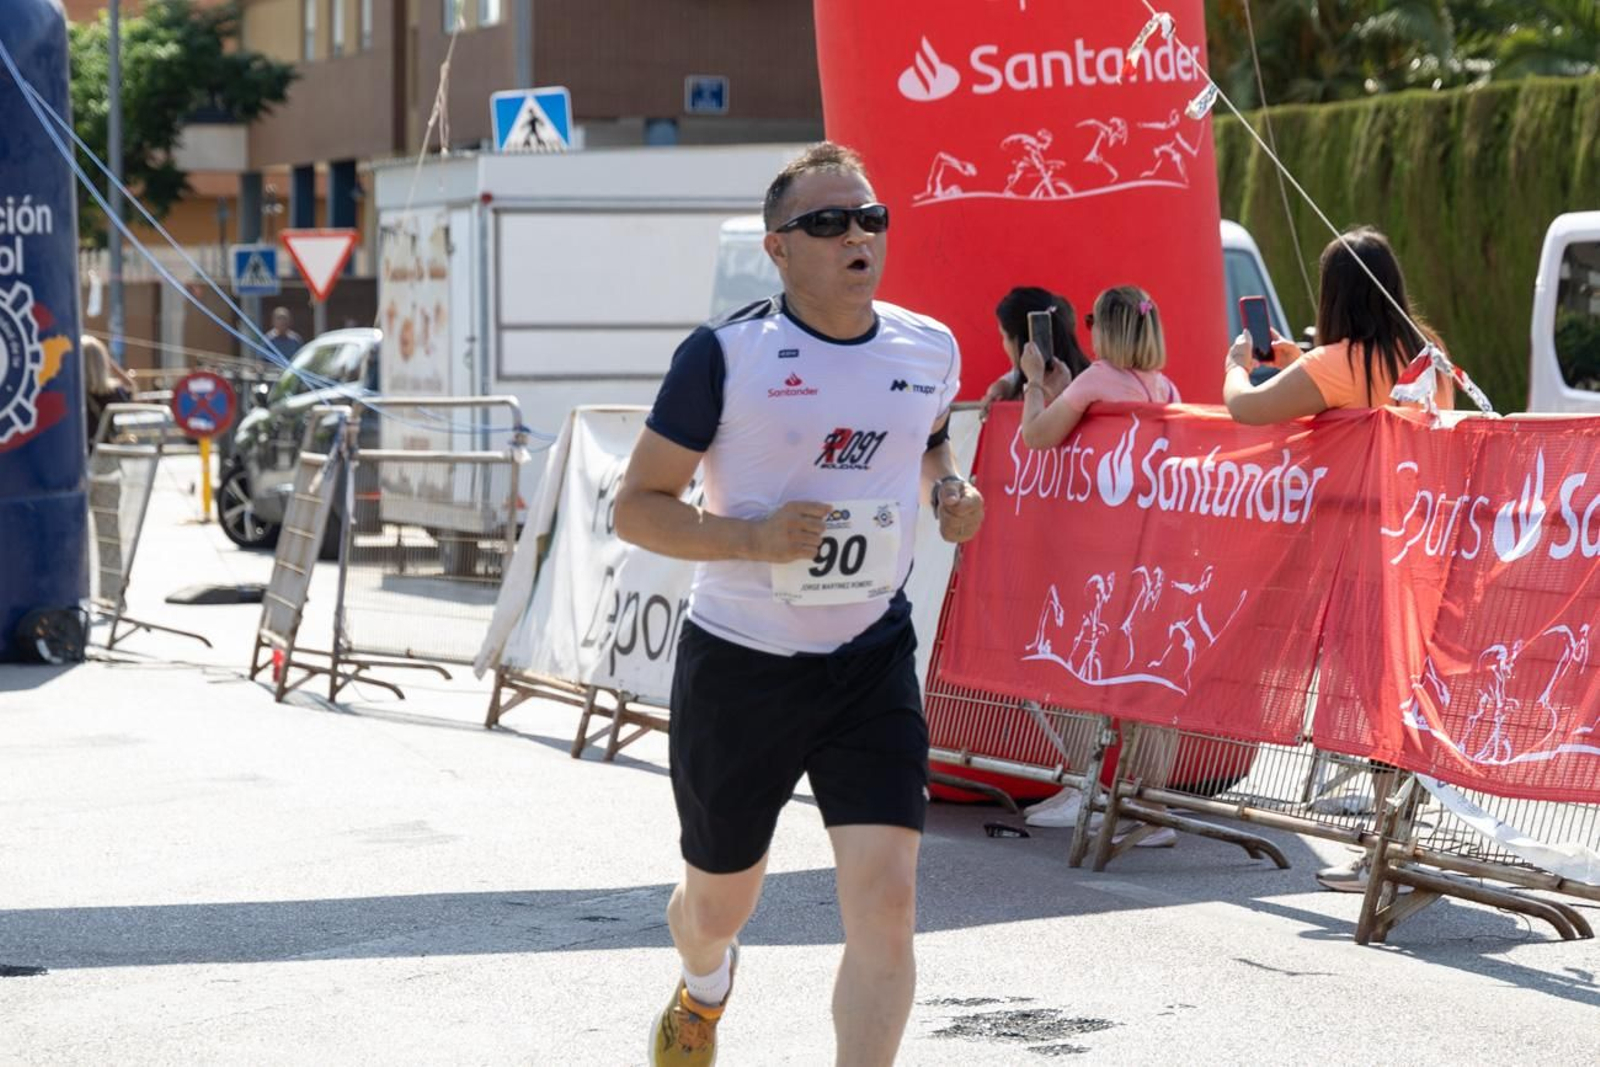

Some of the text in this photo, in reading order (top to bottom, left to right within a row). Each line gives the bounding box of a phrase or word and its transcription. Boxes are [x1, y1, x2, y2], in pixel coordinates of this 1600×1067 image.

[970, 38, 1200, 94] Santander
[768, 387, 818, 398] Santander
[1004, 424, 1329, 524] Sports Santander
[808, 534, 867, 578] 90
